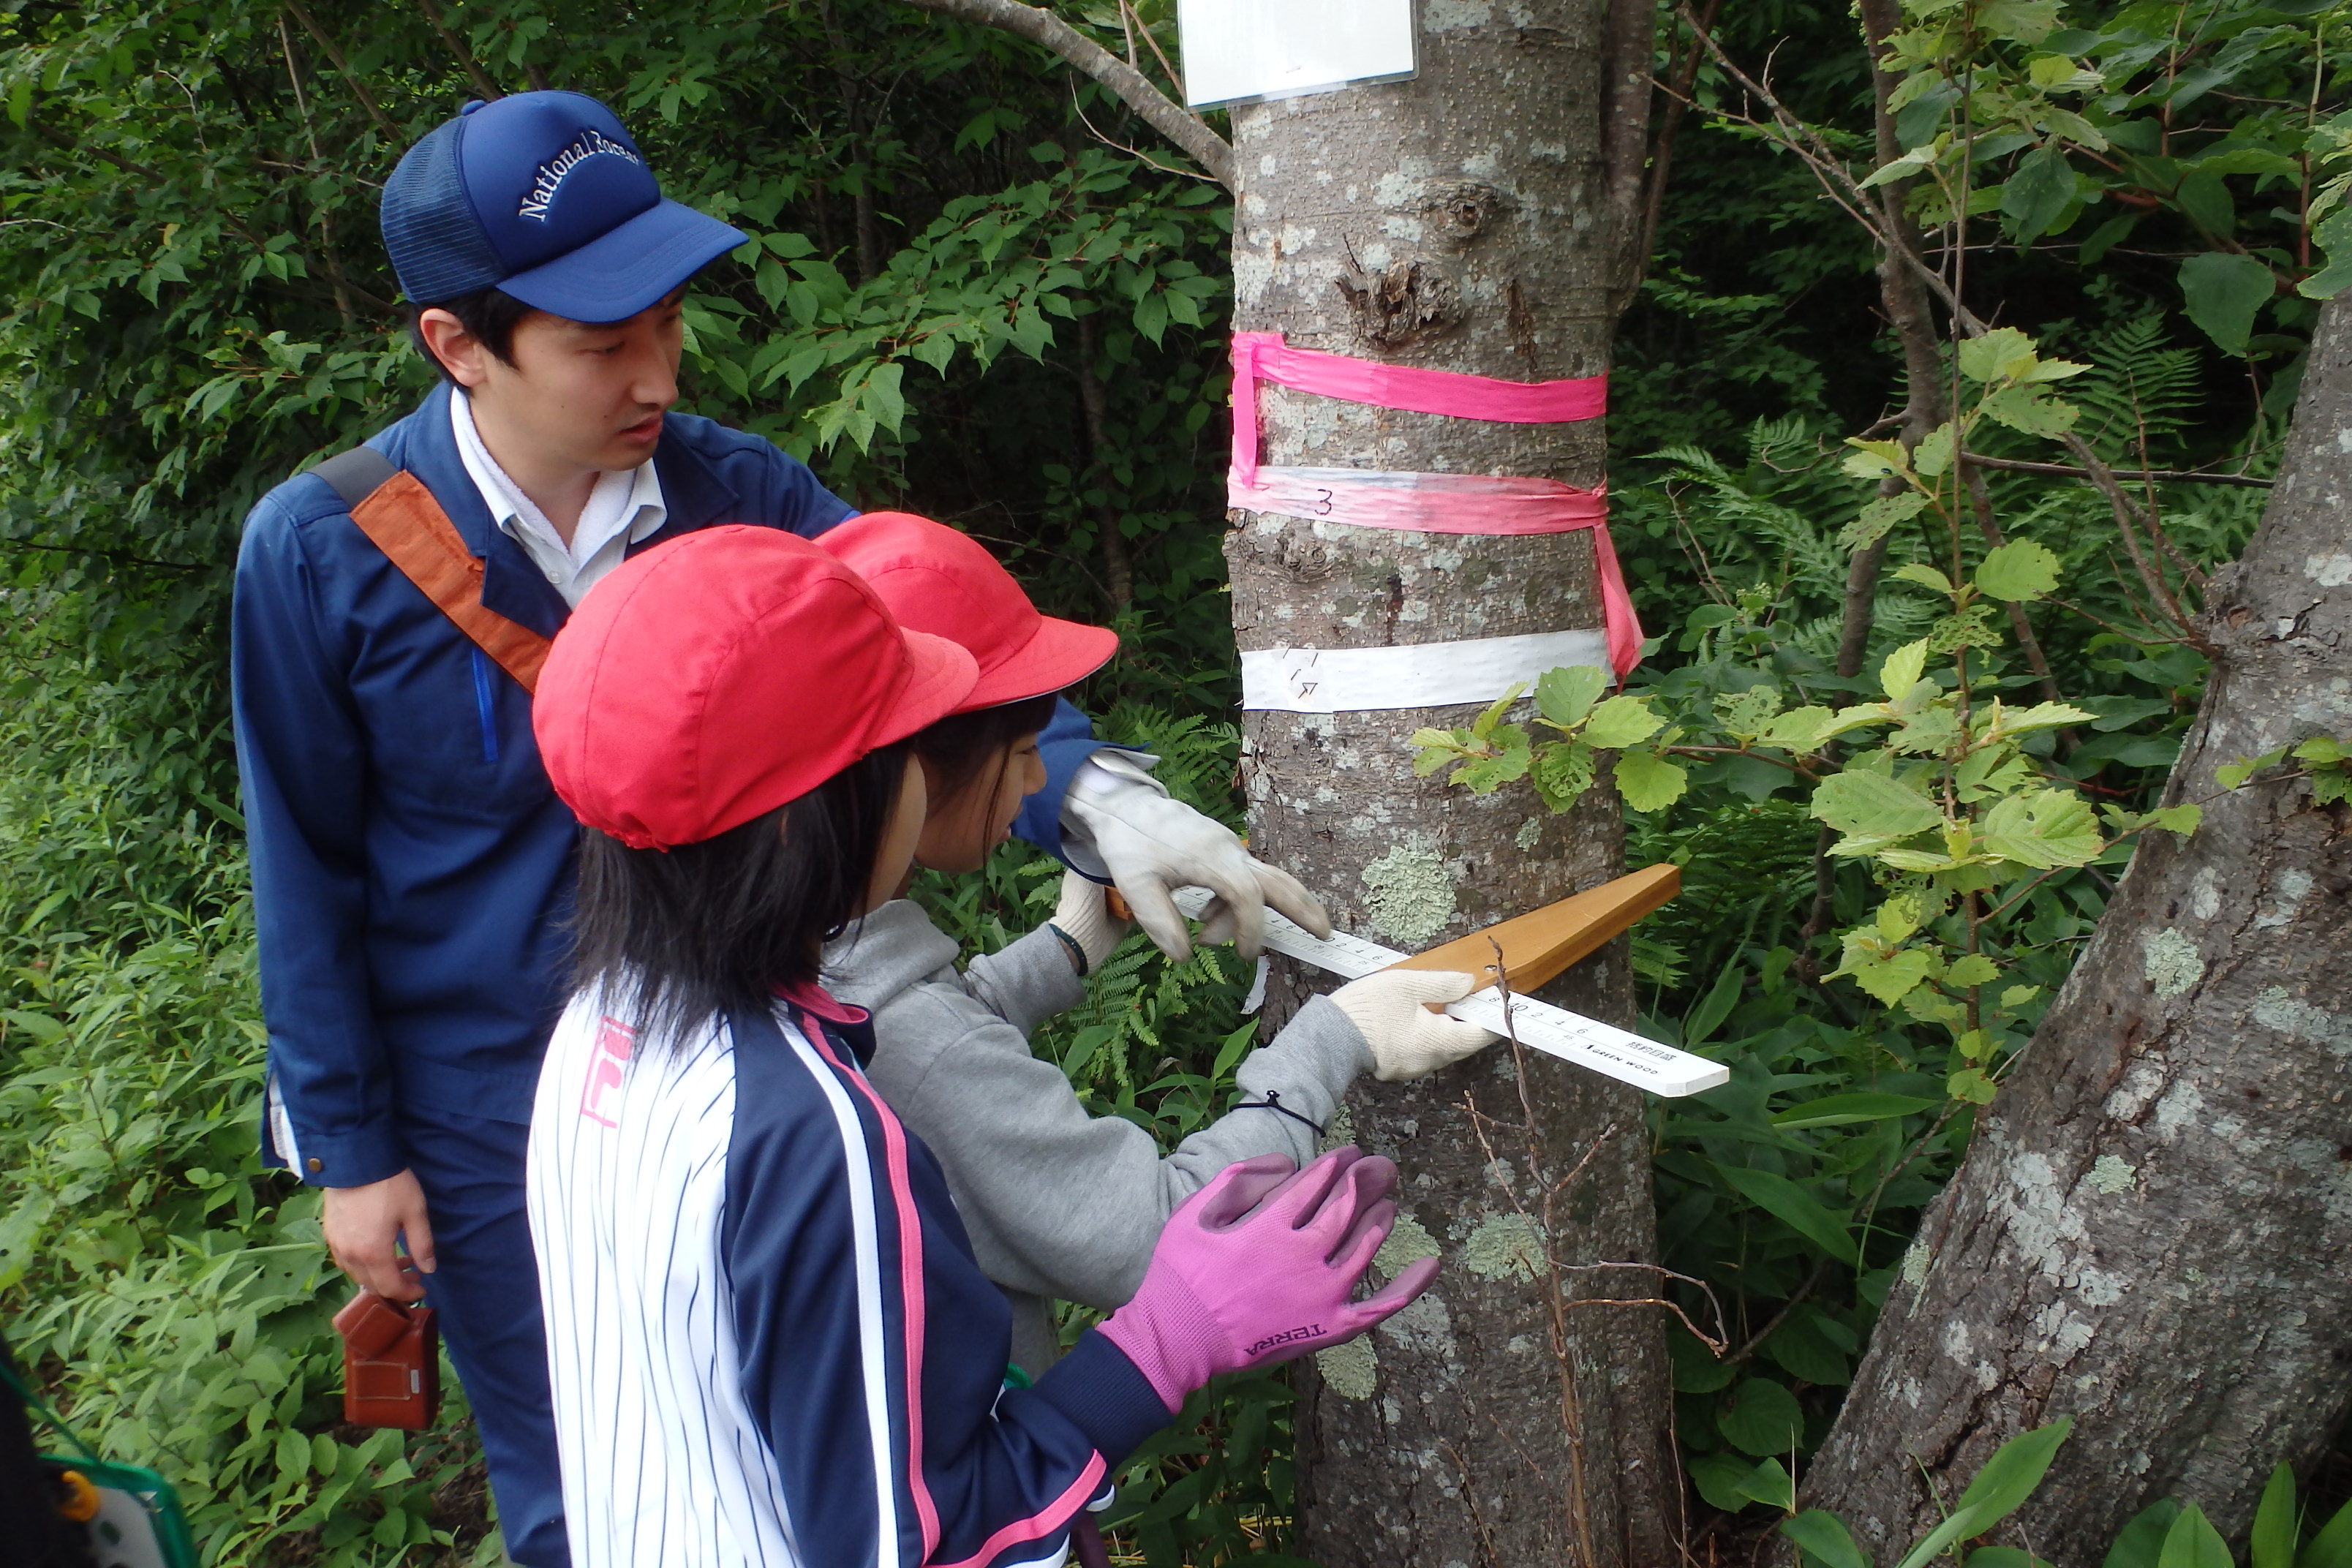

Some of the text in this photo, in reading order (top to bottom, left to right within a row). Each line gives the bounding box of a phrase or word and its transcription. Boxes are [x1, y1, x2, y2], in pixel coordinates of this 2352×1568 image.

[519, 132, 595, 222] National
[1314, 489, 1333, 516] 3
[1508, 1003, 1529, 1012] 40
[1592, 1049, 1658, 1075] GREEN WOOD
[1244, 1324, 1327, 1355] TERRA
